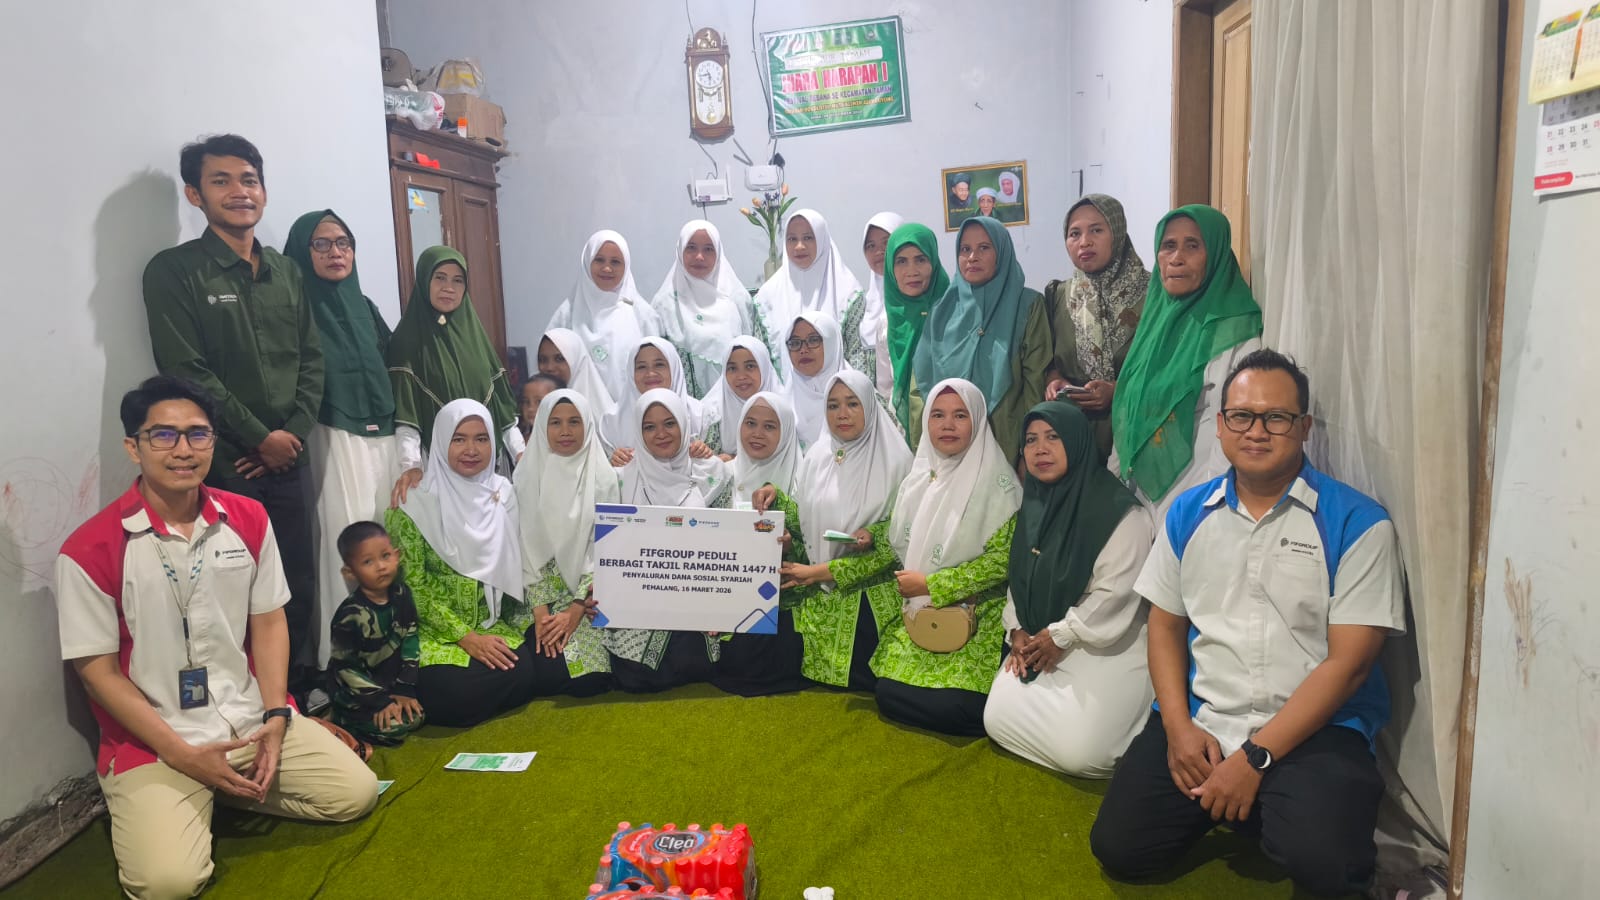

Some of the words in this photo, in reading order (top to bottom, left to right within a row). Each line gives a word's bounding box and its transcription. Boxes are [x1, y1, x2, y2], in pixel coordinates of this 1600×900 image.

[822, 64, 879, 88] HARAPAN
[882, 62, 888, 81] I
[840, 88, 872, 98] KECAMATAN
[640, 548, 694, 558] FIFGROUP
[697, 551, 737, 560] PEDULI
[599, 558, 643, 568] BERBAGI
[646, 561, 680, 570] TAKJIL
[683, 562, 740, 572] RAMADHAN
[742, 565, 766, 573] 1447
[769, 566, 776, 574] H
[642, 584, 680, 592] PEMALANG,
[658, 836, 695, 849] Clea
